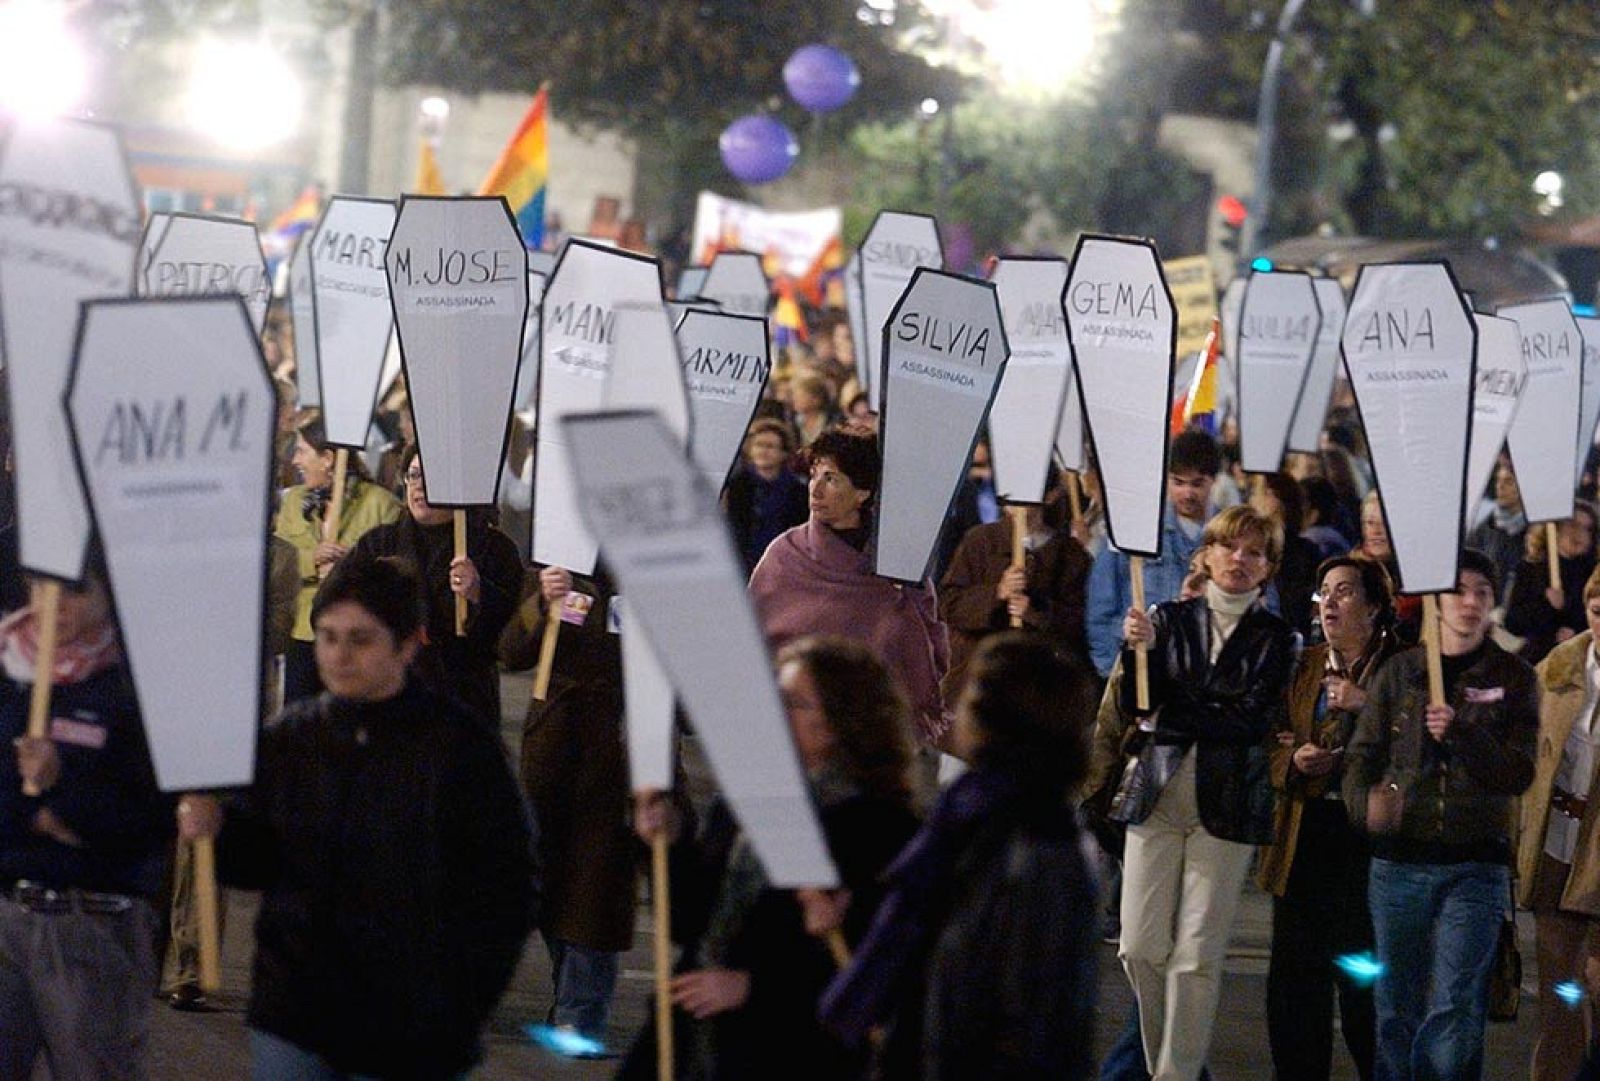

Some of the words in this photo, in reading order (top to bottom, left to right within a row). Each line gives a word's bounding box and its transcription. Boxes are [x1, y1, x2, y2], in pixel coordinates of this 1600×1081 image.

[395, 247, 518, 286] M.JOSE
[416, 297, 495, 306] ASSASSINADA
[1071, 281, 1158, 320] GEMA
[897, 312, 989, 366] SILVIA
[1359, 307, 1435, 353] ANA
[901, 361, 975, 387] ASSASSINADA
[95, 397, 186, 465] ANA
